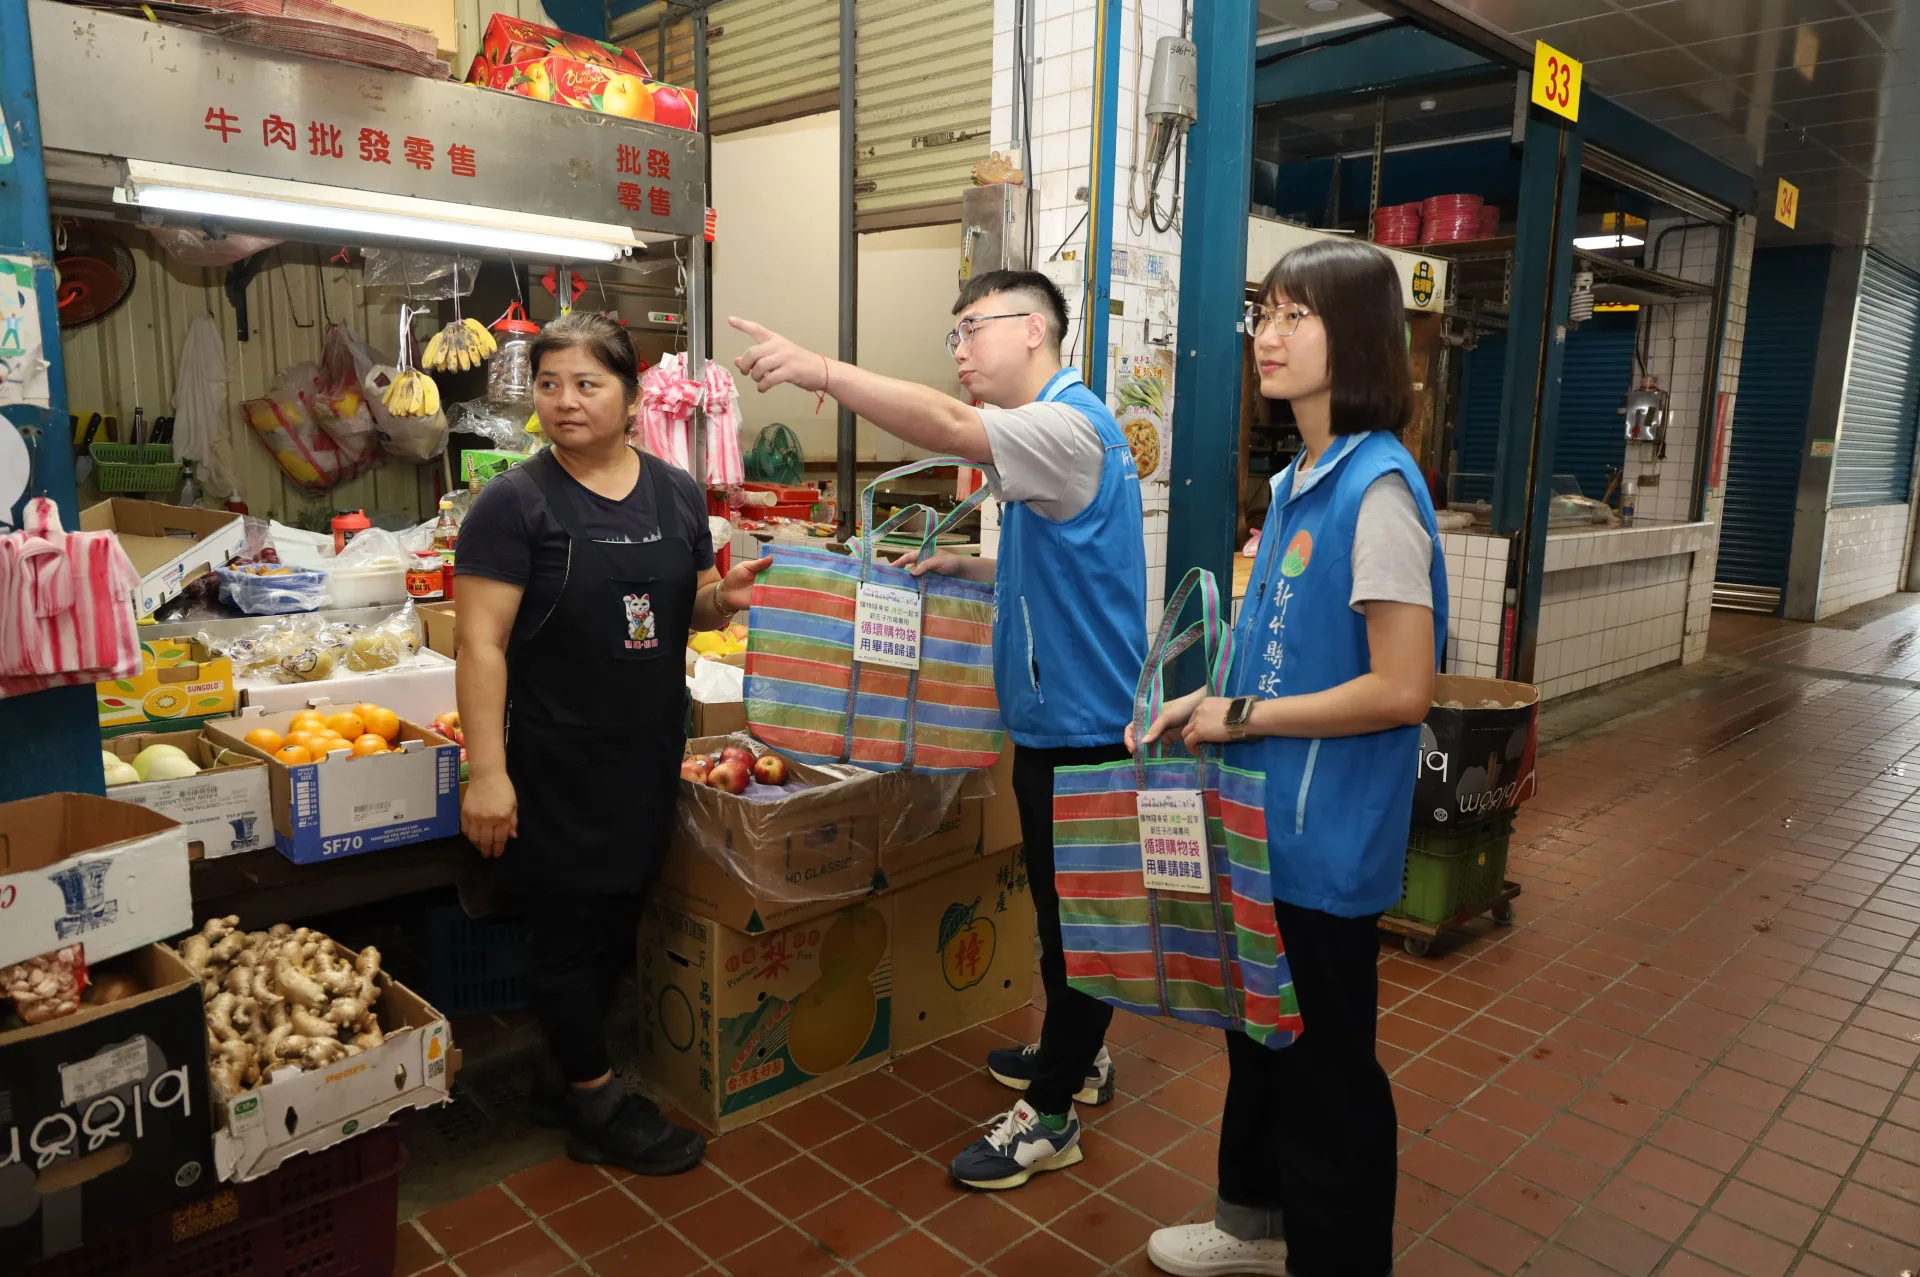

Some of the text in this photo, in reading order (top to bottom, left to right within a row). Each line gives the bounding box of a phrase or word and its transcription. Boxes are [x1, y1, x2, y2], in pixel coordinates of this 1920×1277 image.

[1545, 57, 1571, 107] 33
[205, 107, 476, 177] 牛肉批發零售
[616, 144, 671, 180] 批發
[616, 181, 671, 217] 零售
[1780, 187, 1793, 218] 34
[861, 621, 917, 642] 循環購物袋
[1258, 578, 1294, 699] 新竹縣政
[860, 637, 916, 659] 用畢請歸還
[322, 836, 363, 855] SF70
[1144, 838, 1200, 857] 循環購物袋
[805, 856, 852, 881] CLASSIC
[1147, 859, 1202, 879] 用畢請歸還
